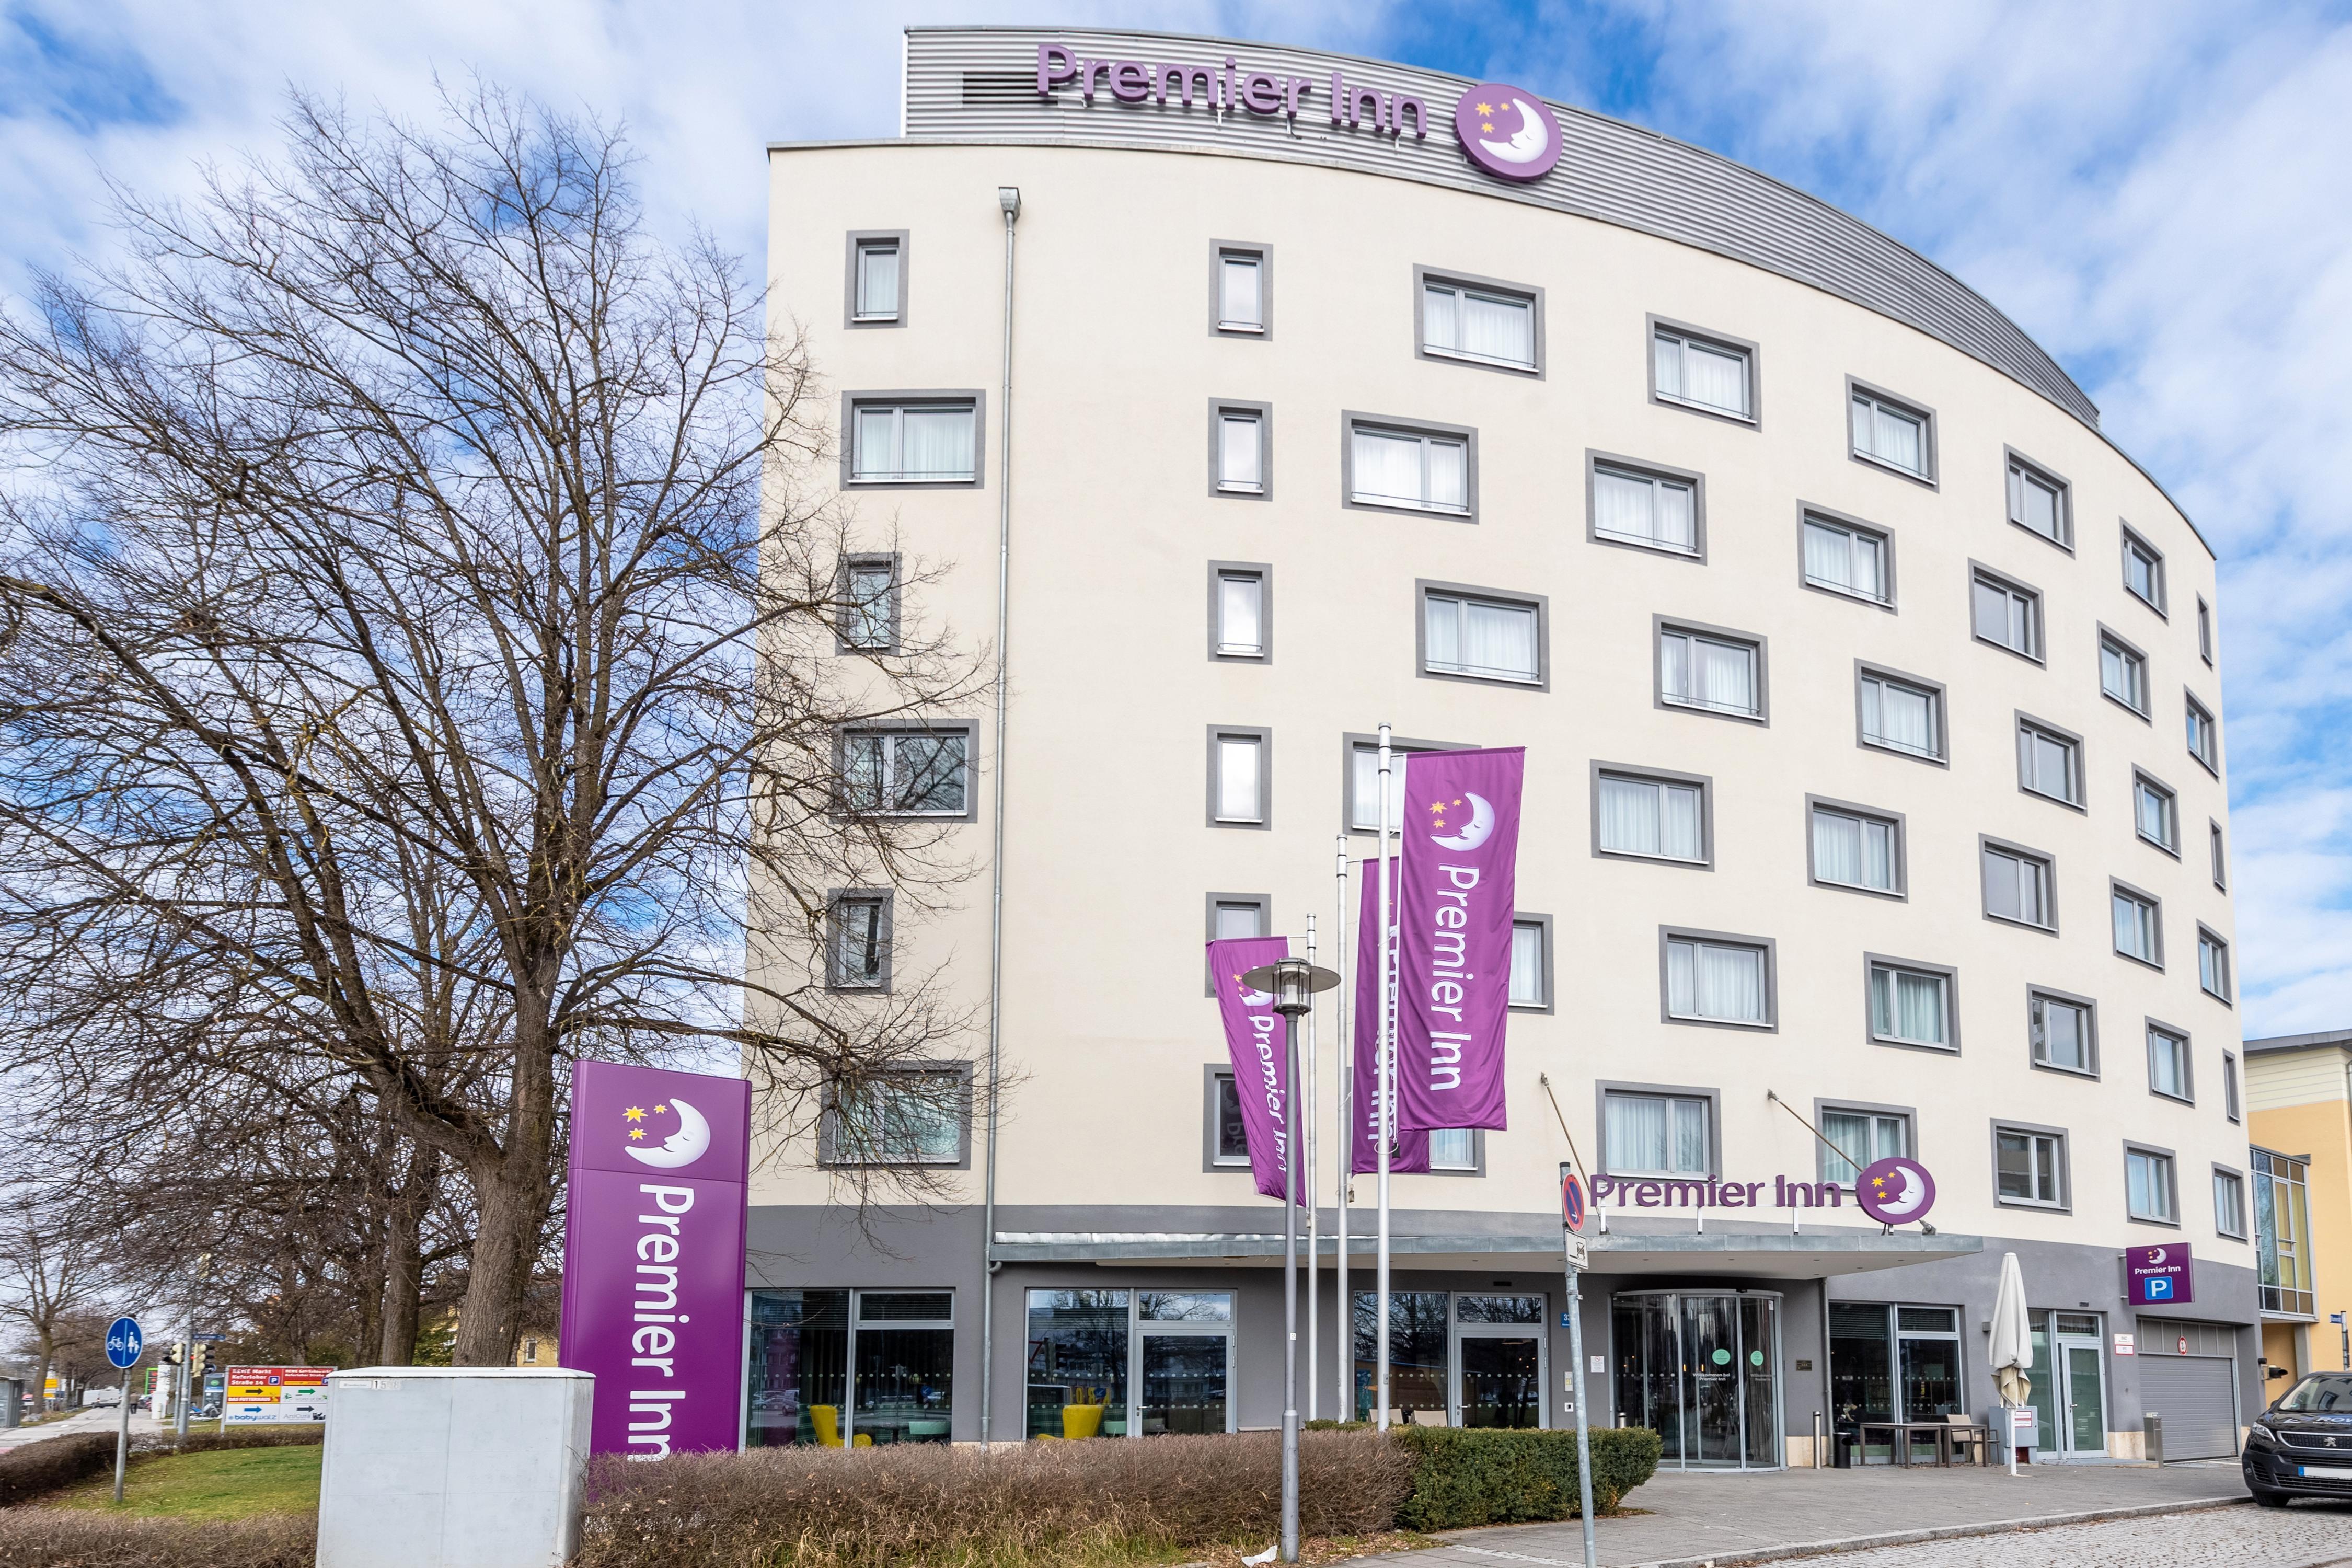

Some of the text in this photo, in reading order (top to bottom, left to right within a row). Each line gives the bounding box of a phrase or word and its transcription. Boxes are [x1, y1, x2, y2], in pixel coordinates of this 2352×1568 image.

[1038, 44, 1427, 139] Premier Inn
[1429, 863, 1480, 1091] Premier Inn
[1248, 1015, 1285, 1125] Premier
[1590, 1174, 1841, 1207] Premier Inn
[2135, 1266, 2166, 1275] Premier
[2151, 1279, 2167, 1297] P
[627, 1184, 695, 1462] Premier Inn
